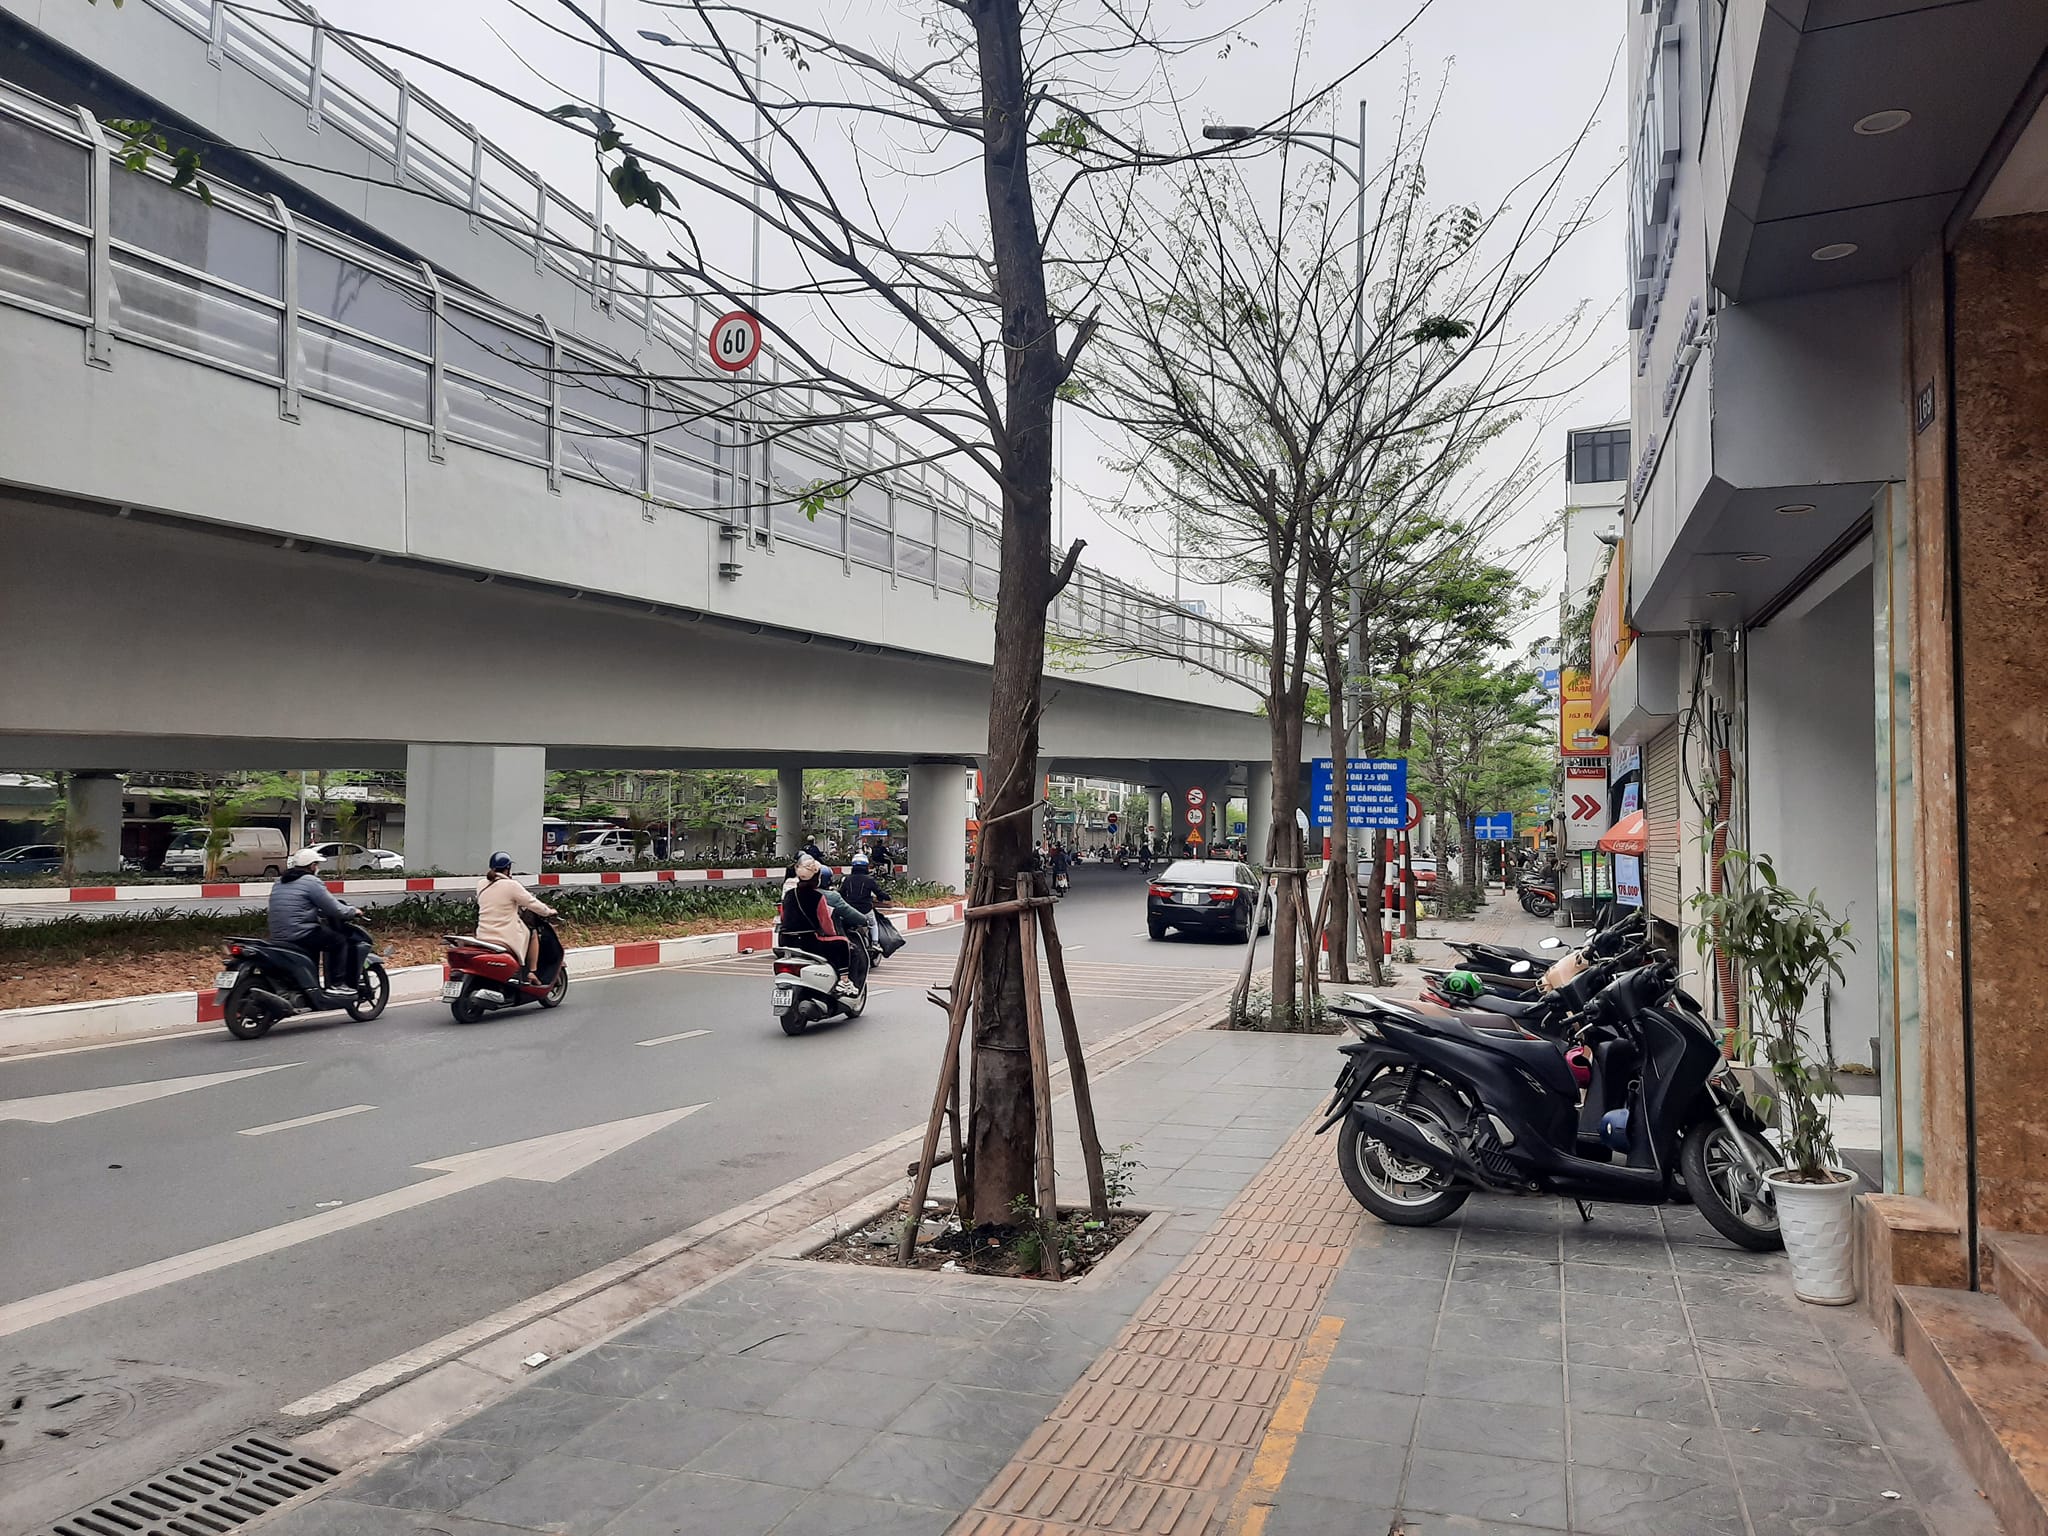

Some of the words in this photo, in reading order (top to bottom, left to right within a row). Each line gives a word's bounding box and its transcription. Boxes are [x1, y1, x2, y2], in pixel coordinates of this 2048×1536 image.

[723, 328, 746, 355] 60
[1918, 388, 1932, 424] 169
[1364, 773, 1375, 781] 2.5
[1351, 782, 1366, 791] GIẢI
[1367, 783, 1392, 792] PHÓNG
[1357, 794, 1378, 802] CÔNG
[1379, 794, 1394, 802] CÁC
[1350, 804, 1366, 814] TIỆN
[1367, 806, 1383, 815] HẠN
[1384, 803, 1399, 813] CHẾ
[1378, 815, 1399, 824] CÔNG
